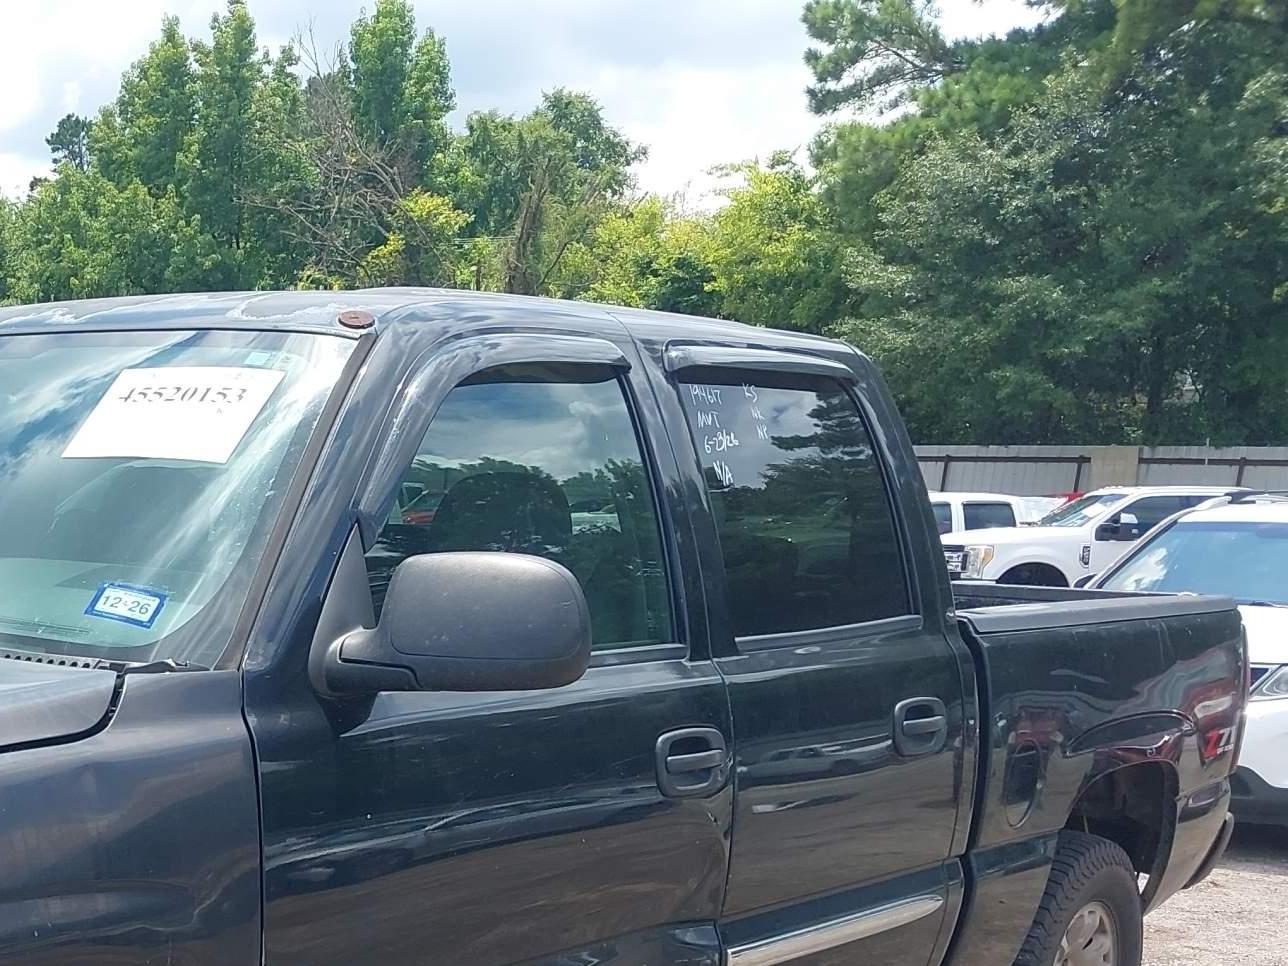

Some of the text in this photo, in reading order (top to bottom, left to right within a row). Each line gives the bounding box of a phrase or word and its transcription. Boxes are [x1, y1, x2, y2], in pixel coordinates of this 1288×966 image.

[118, 386, 248, 404] 45520153
[713, 460, 734, 486] N/A
[1204, 726, 1237, 760] Z71
